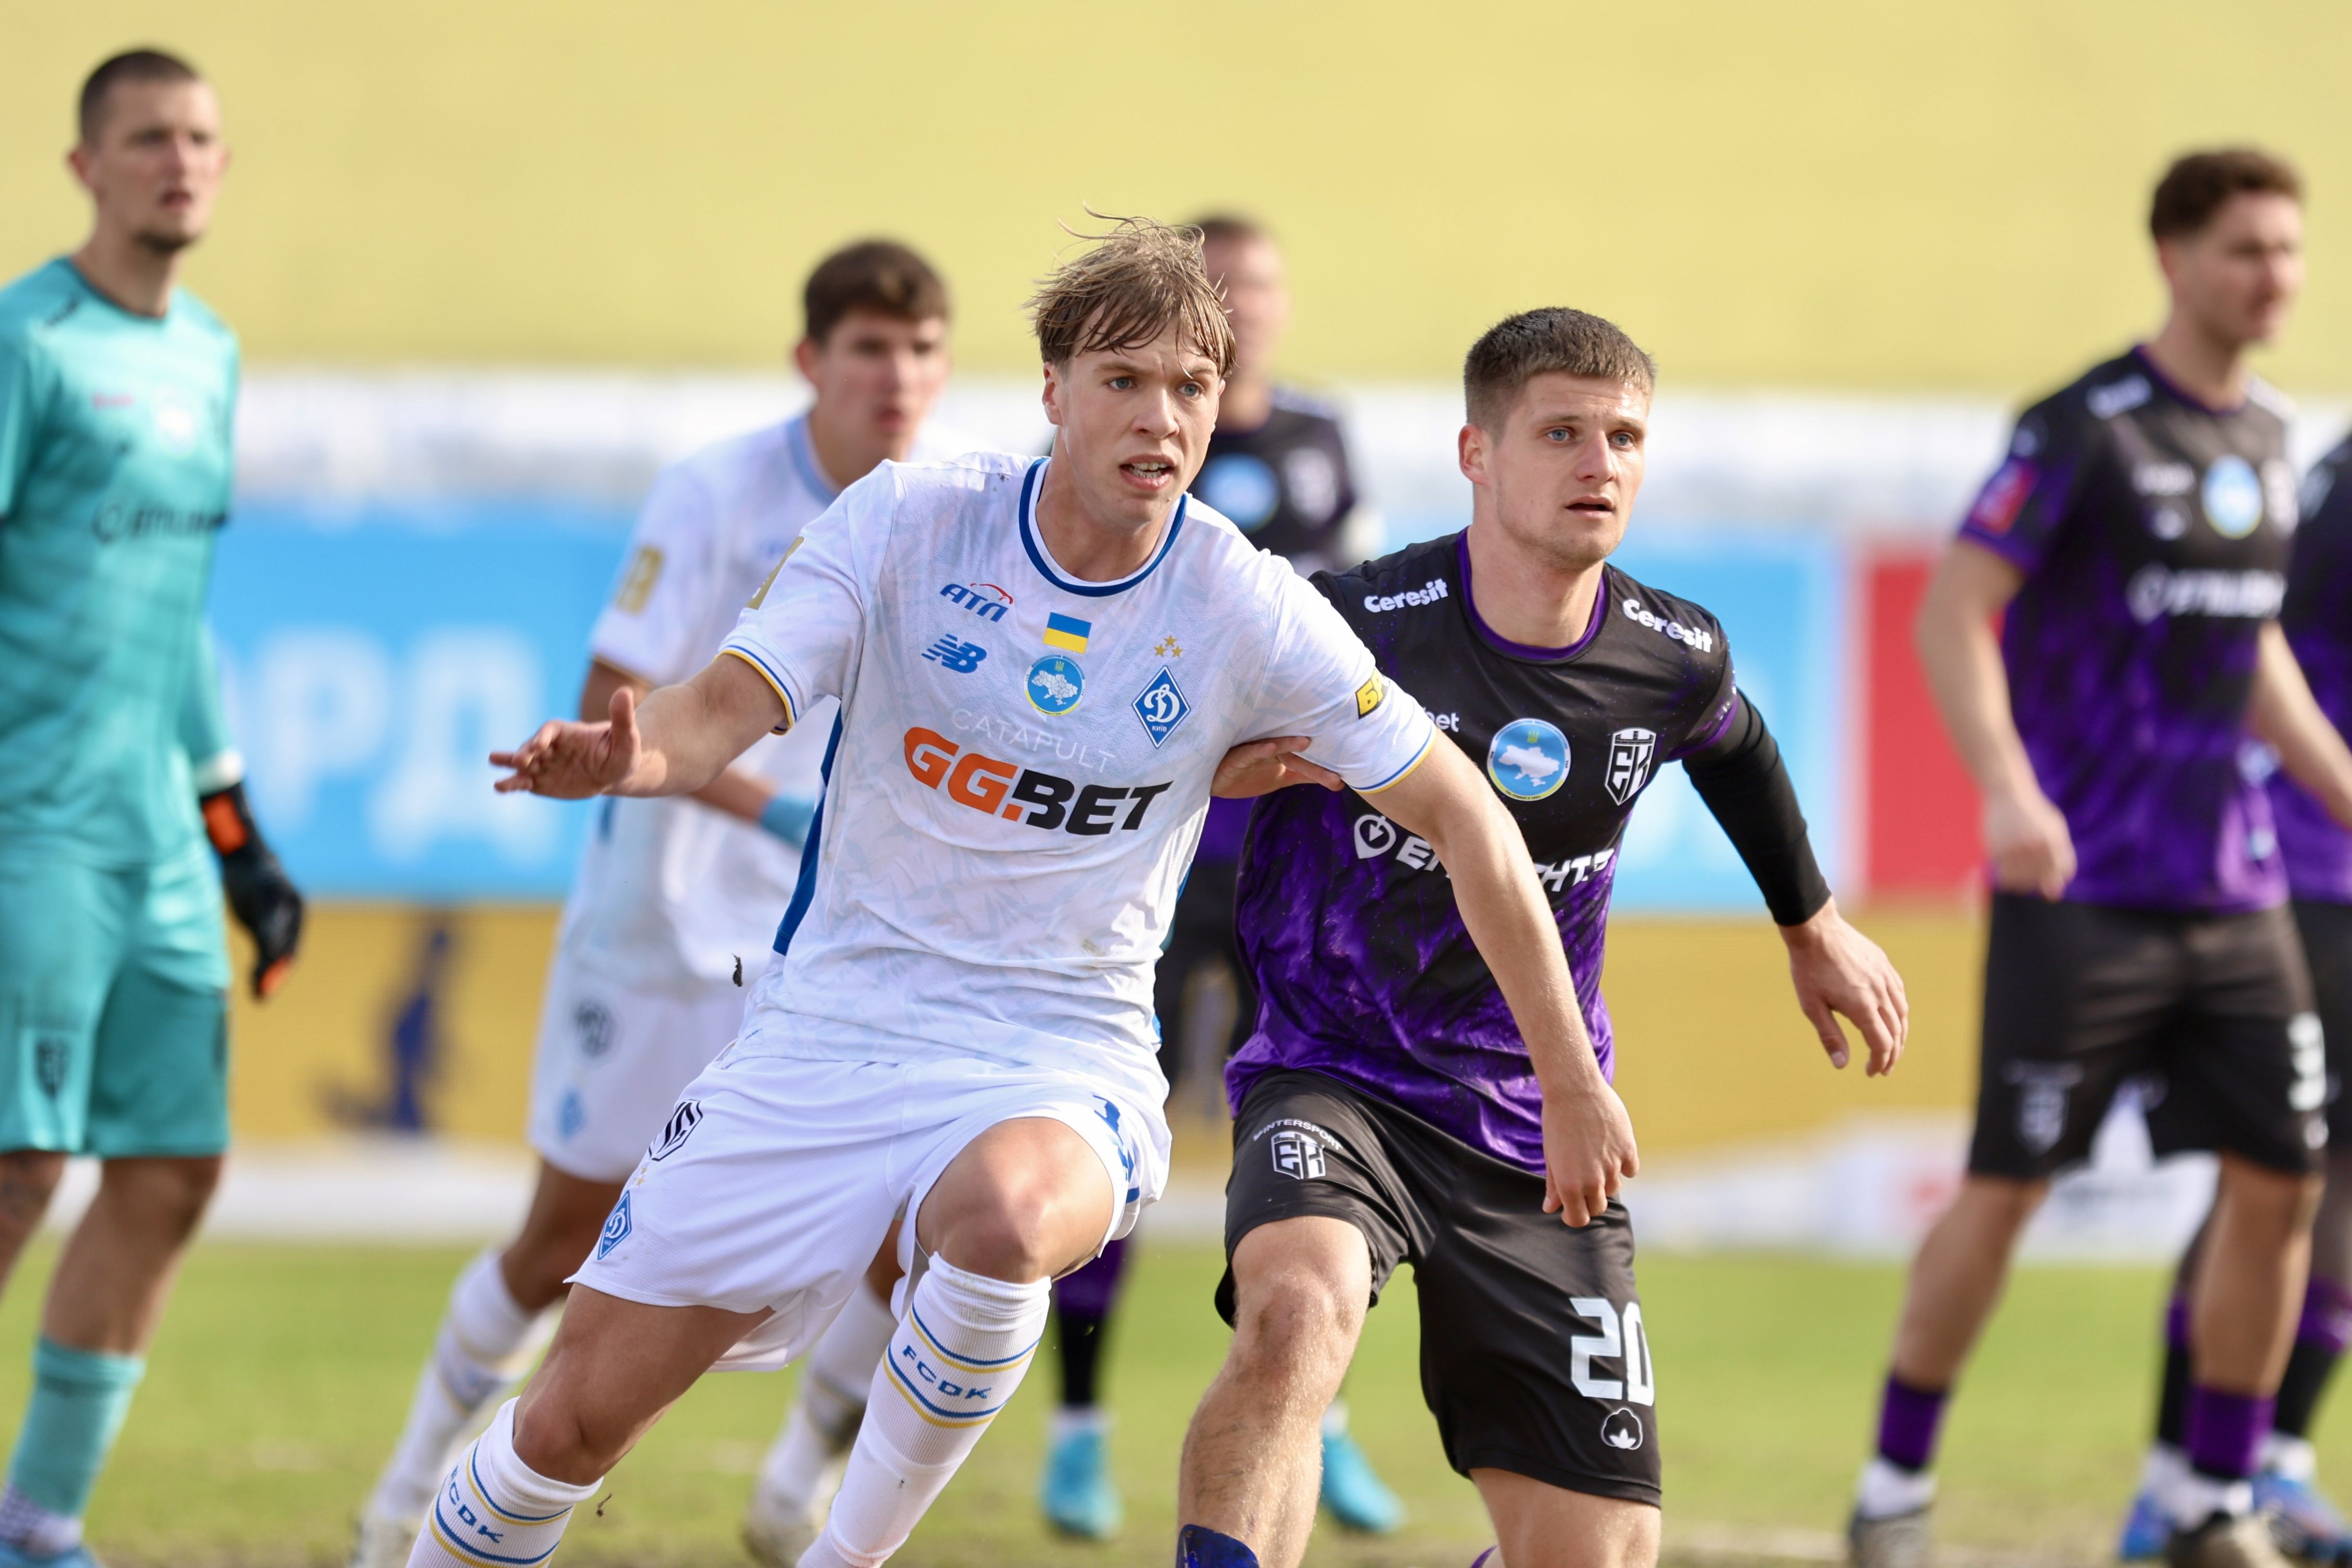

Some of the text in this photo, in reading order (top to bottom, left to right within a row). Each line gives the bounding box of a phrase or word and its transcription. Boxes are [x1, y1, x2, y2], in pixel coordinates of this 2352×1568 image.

[1364, 578, 1448, 613] Ceresit
[1623, 599, 1713, 653] Ceresit
[952, 709, 1116, 774] CATAPULT
[904, 726, 1174, 836] GG.BET
[902, 1344, 992, 1400] FCDK
[1569, 1297, 1654, 1407] 20
